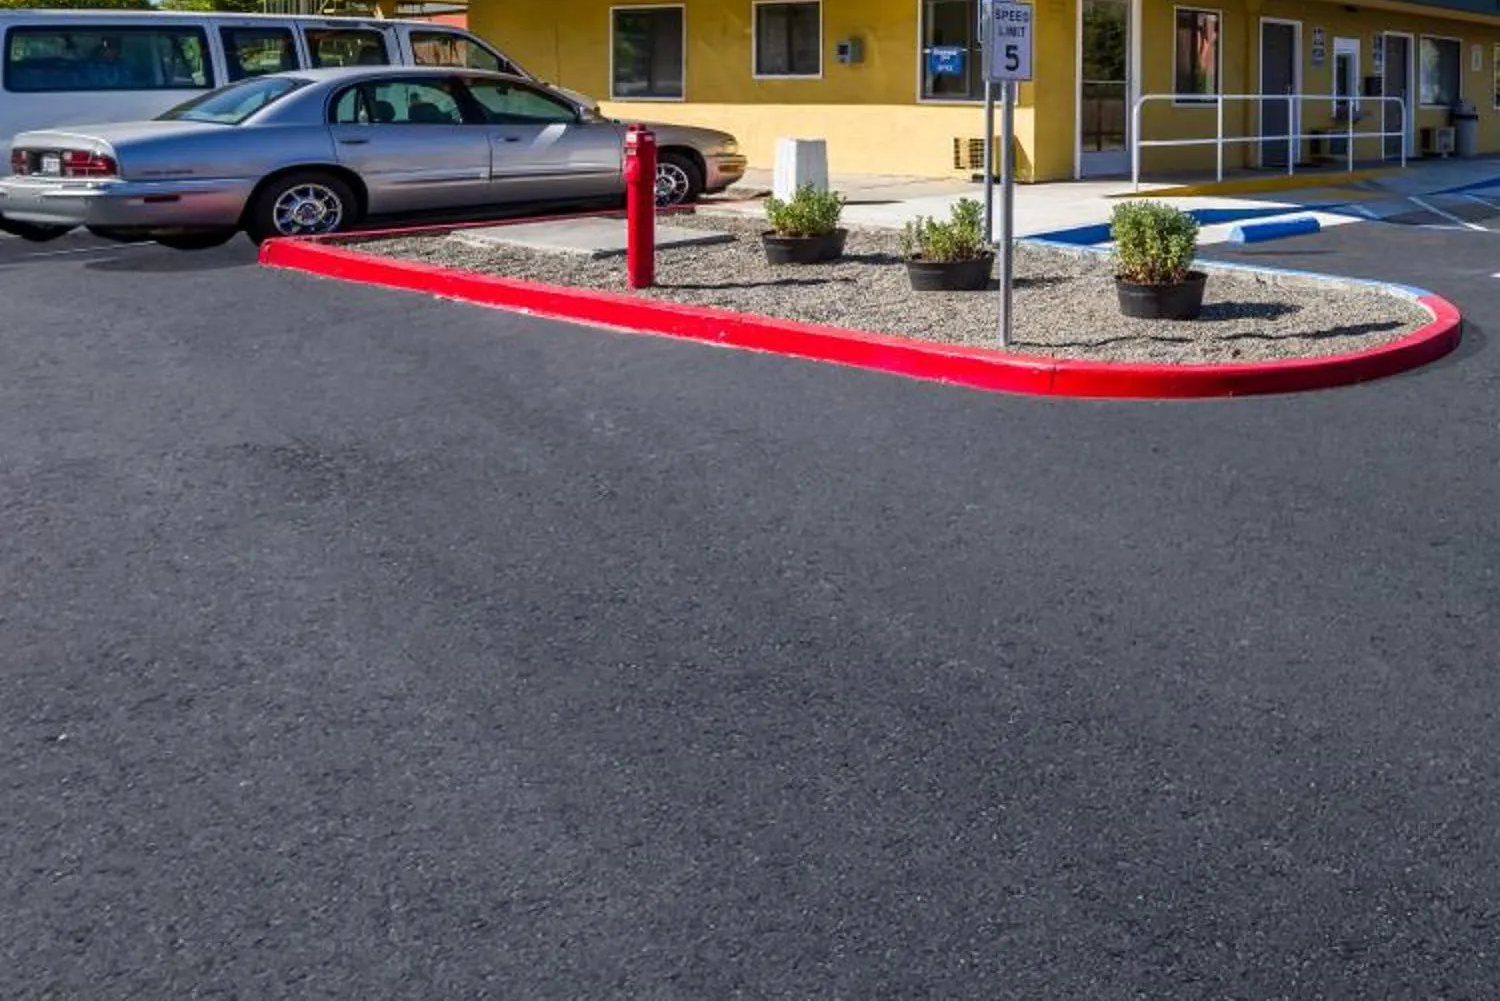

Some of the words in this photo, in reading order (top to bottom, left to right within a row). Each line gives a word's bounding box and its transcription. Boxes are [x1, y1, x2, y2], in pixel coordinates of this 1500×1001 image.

[995, 9, 1029, 22] SPEED
[998, 26, 1025, 38] LIMIT
[1004, 44, 1020, 72] 5
